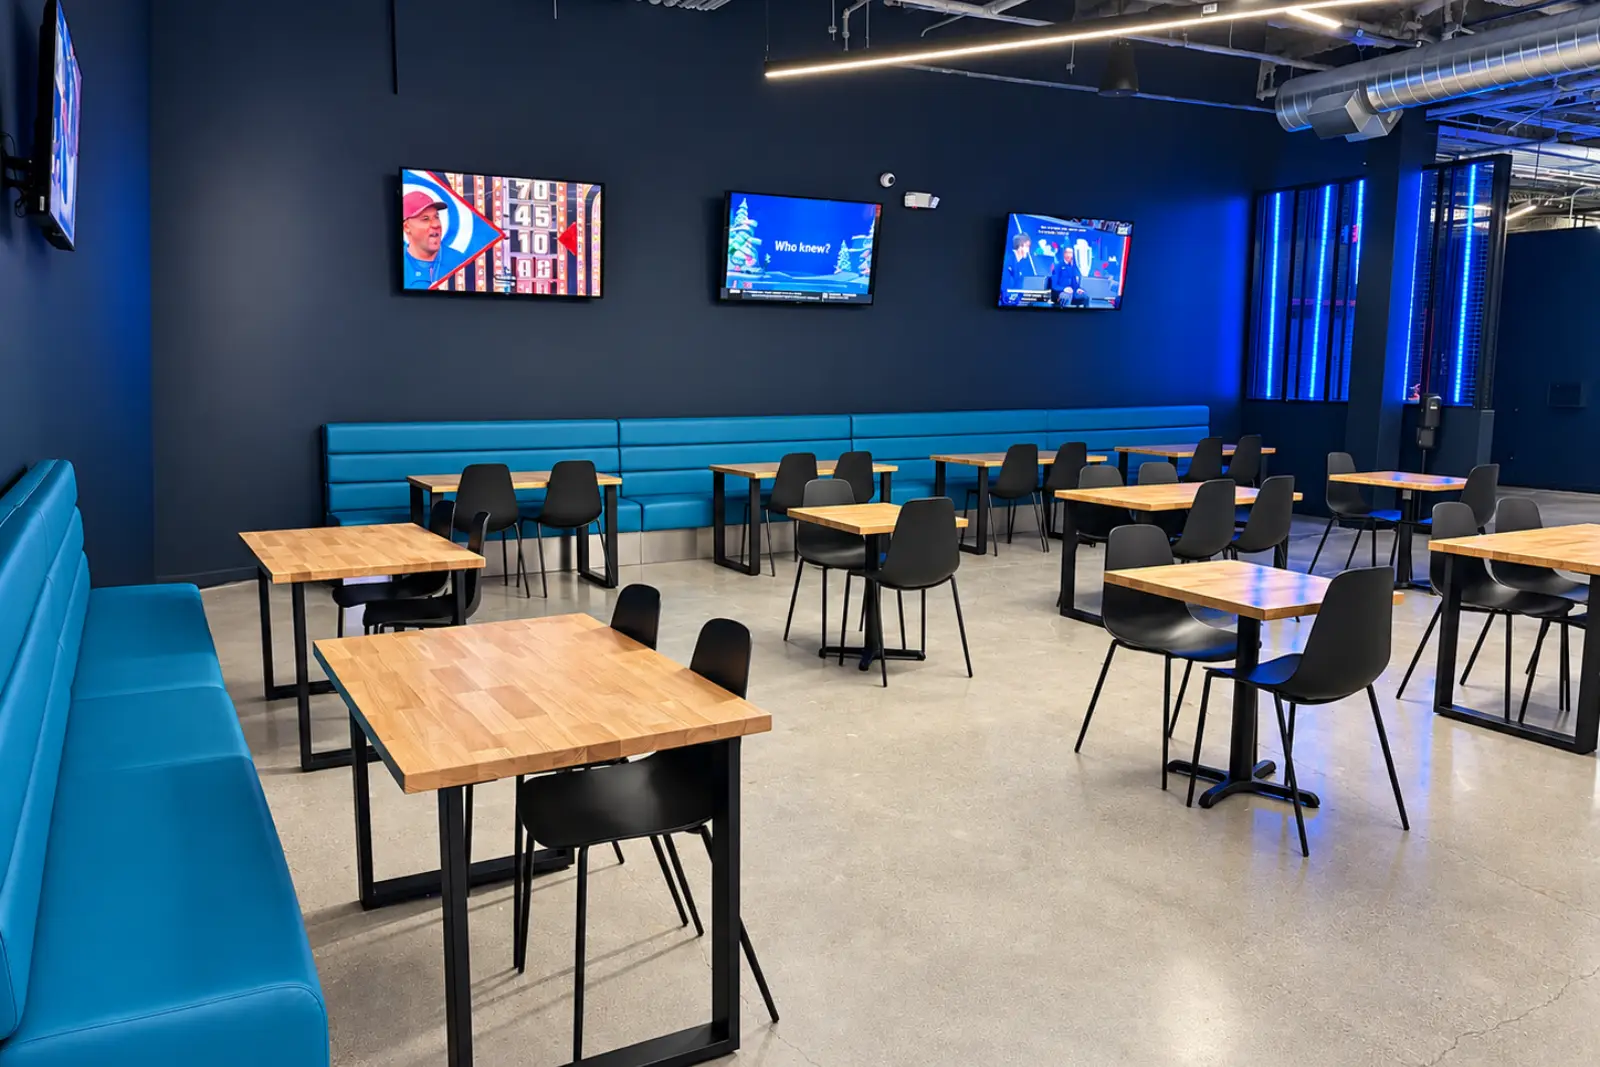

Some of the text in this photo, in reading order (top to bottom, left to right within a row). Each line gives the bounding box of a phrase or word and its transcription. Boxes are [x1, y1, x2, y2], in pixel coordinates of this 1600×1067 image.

[516, 180, 549, 200] 70
[514, 205, 550, 228] 45
[518, 231, 549, 255] 10
[775, 240, 831, 254] Who knew?
